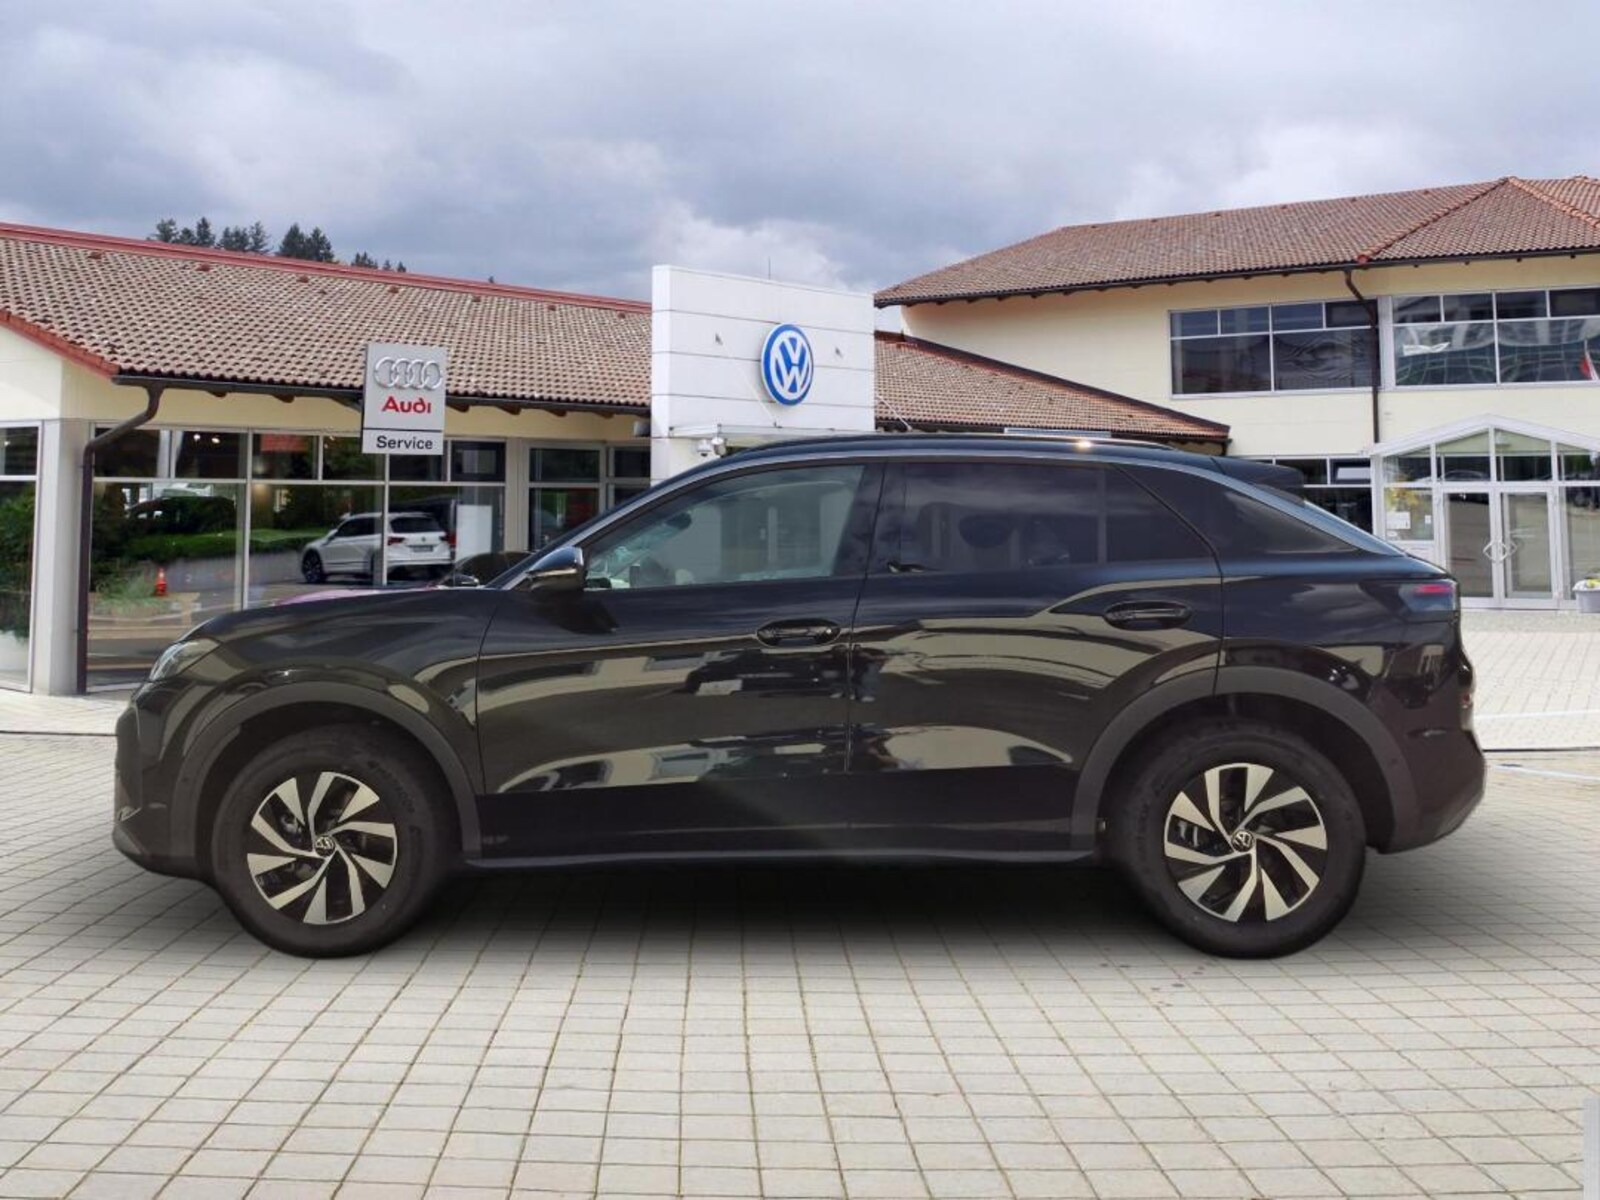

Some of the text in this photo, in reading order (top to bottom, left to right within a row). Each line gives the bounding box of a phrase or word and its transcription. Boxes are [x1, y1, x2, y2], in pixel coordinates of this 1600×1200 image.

[767, 328, 811, 401] VW
[382, 396, 432, 414] Audi
[376, 435, 433, 450] Service
